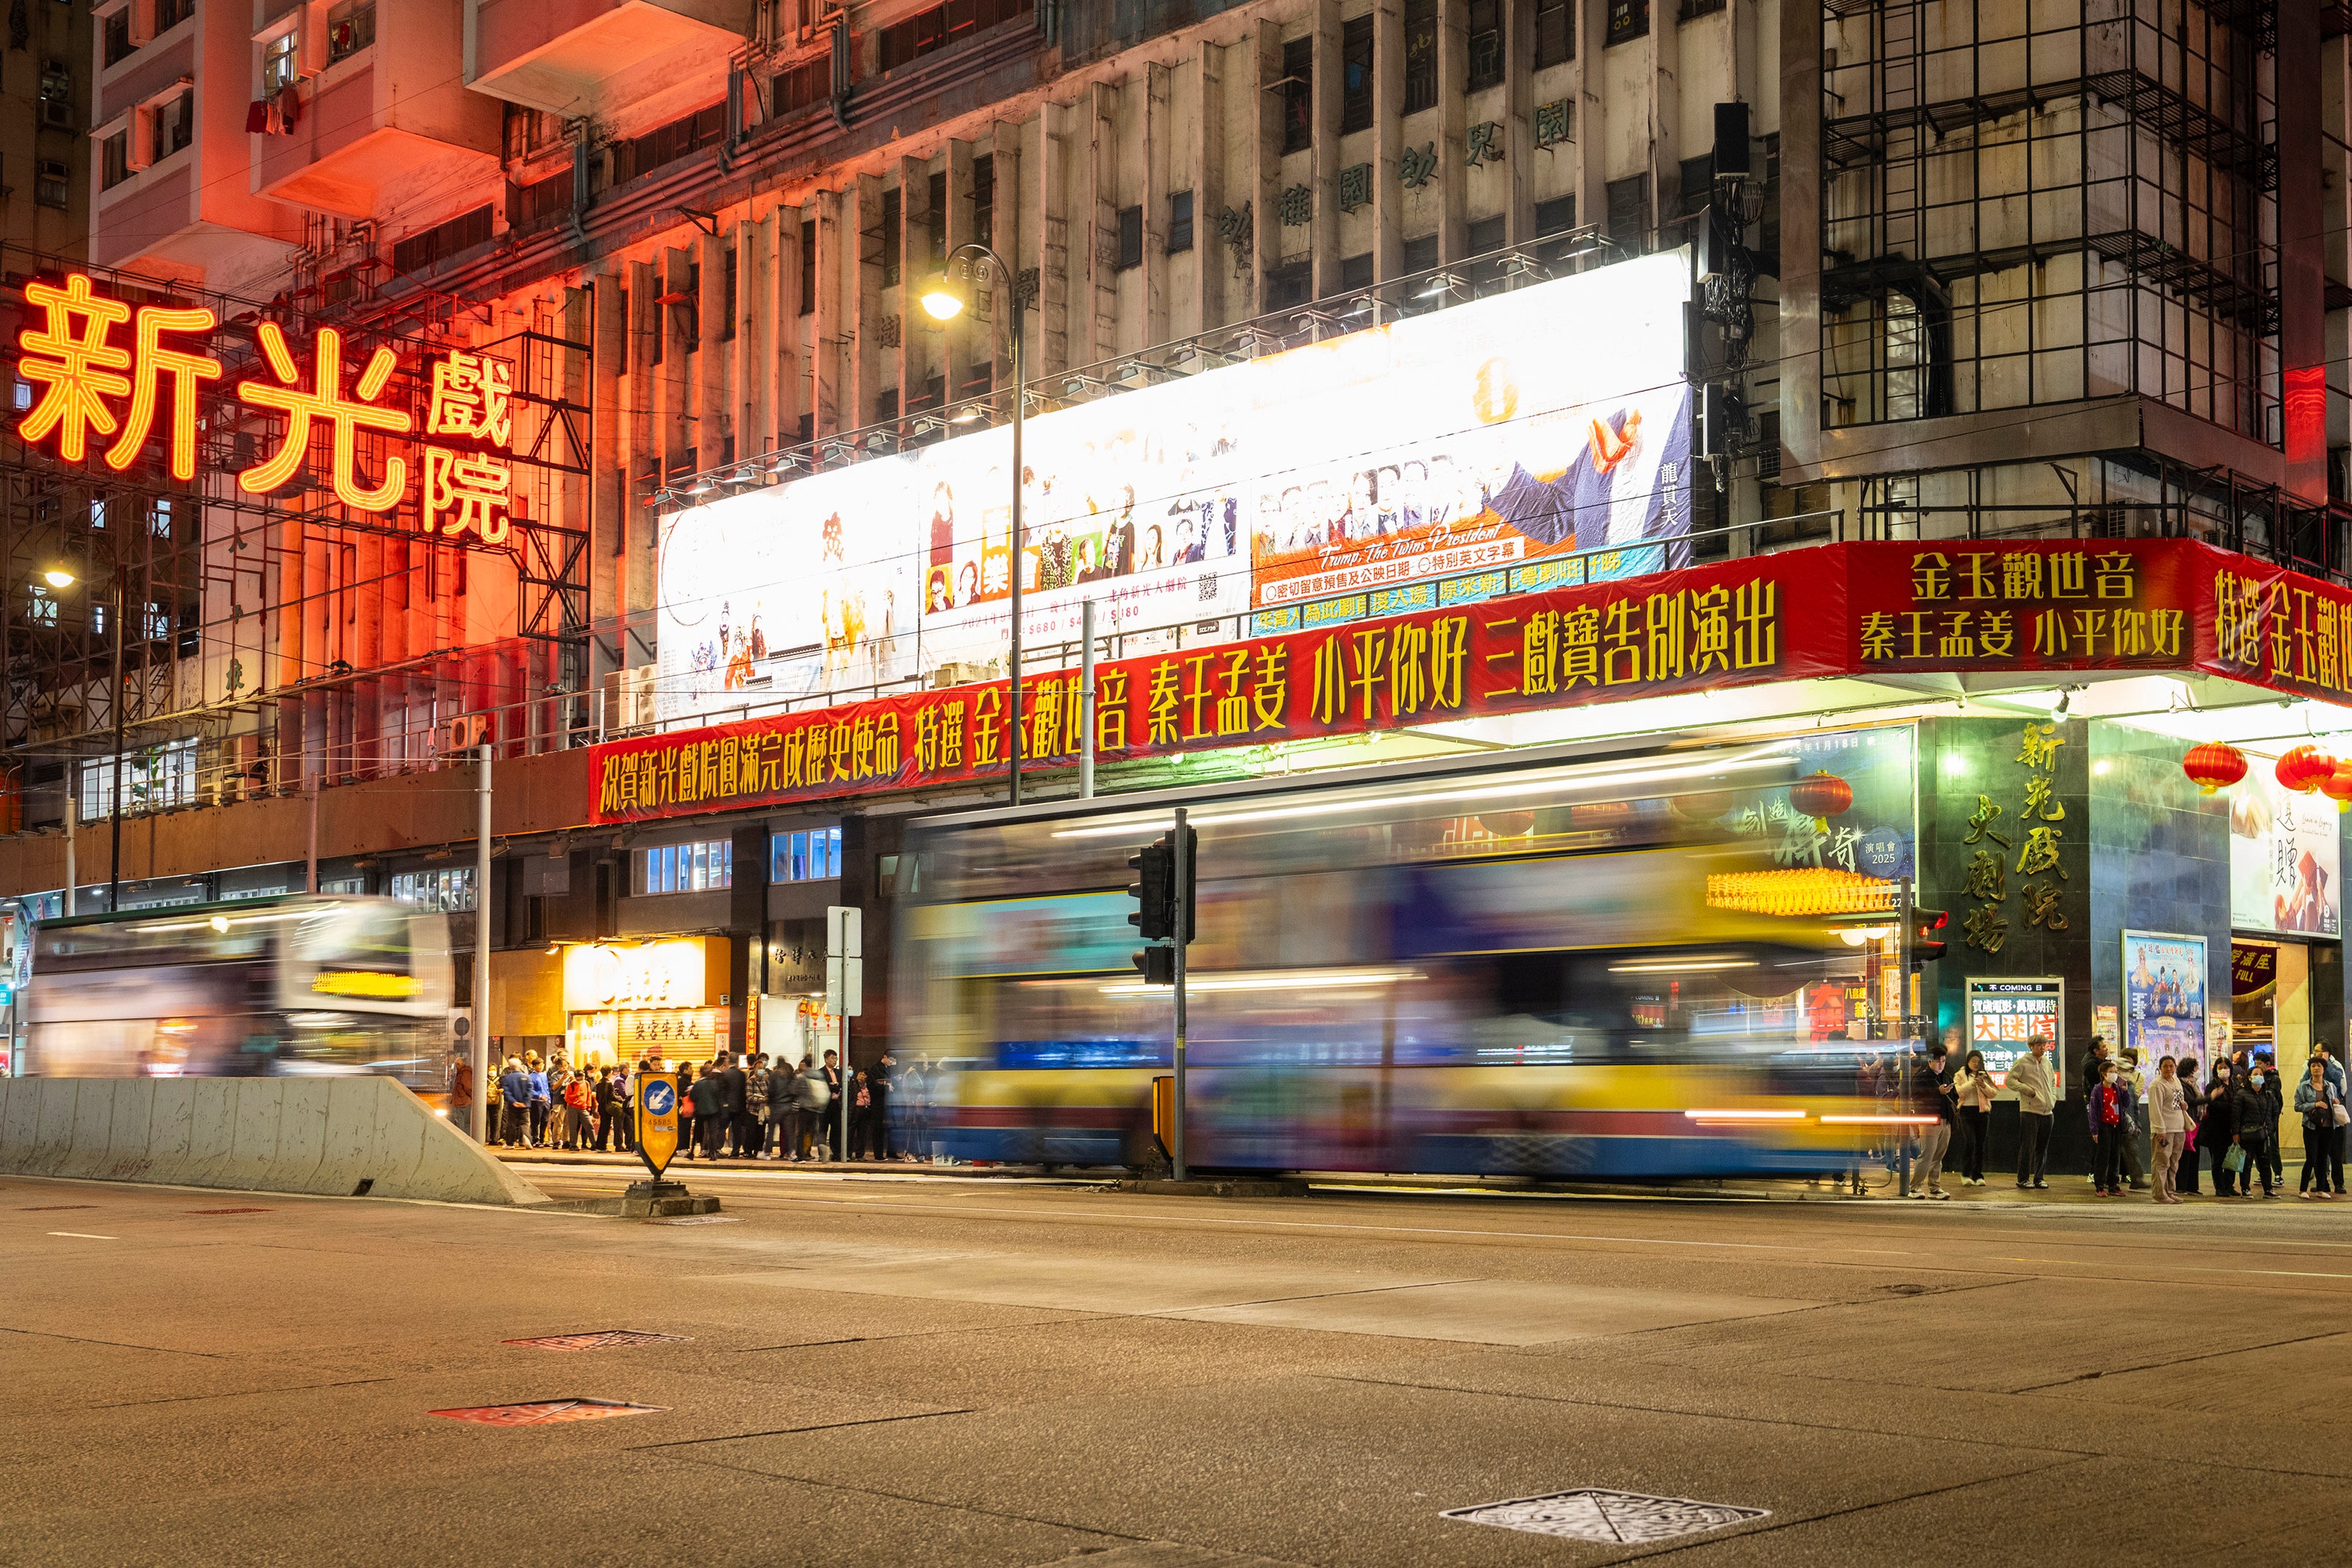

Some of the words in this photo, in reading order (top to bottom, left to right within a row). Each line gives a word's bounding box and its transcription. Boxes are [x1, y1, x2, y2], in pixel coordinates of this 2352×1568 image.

[19, 273, 410, 511] 新光
[424, 349, 511, 544] 戲院
[1660, 462, 1678, 529] 龍貫天
[1319, 544, 1363, 570] Trump,
[1363, 541, 1388, 567] The
[1390, 536, 1427, 560] Twins
[1428, 519, 1505, 551] President
[1910, 551, 2135, 600] 金玉觀世音
[1860, 610, 2015, 660] 秦王孟姜
[2033, 608, 2185, 657] 小平你好
[2215, 568, 2260, 667] 特選
[600, 711, 900, 813] 祝賀新光戲院圓滿完成歷史使命
[914, 699, 965, 773] 特選
[1148, 641, 1288, 745] 秦王孟姜
[1310, 615, 1468, 725] 小平你好
[1484, 576, 1776, 699] 三戲寶告別演出
[1865, 841, 1896, 853] 演唱會
[1872, 853, 1896, 864] 2025
[2235, 969, 2254, 982] FULL
[1973, 1014, 2058, 1043] 大迷信
